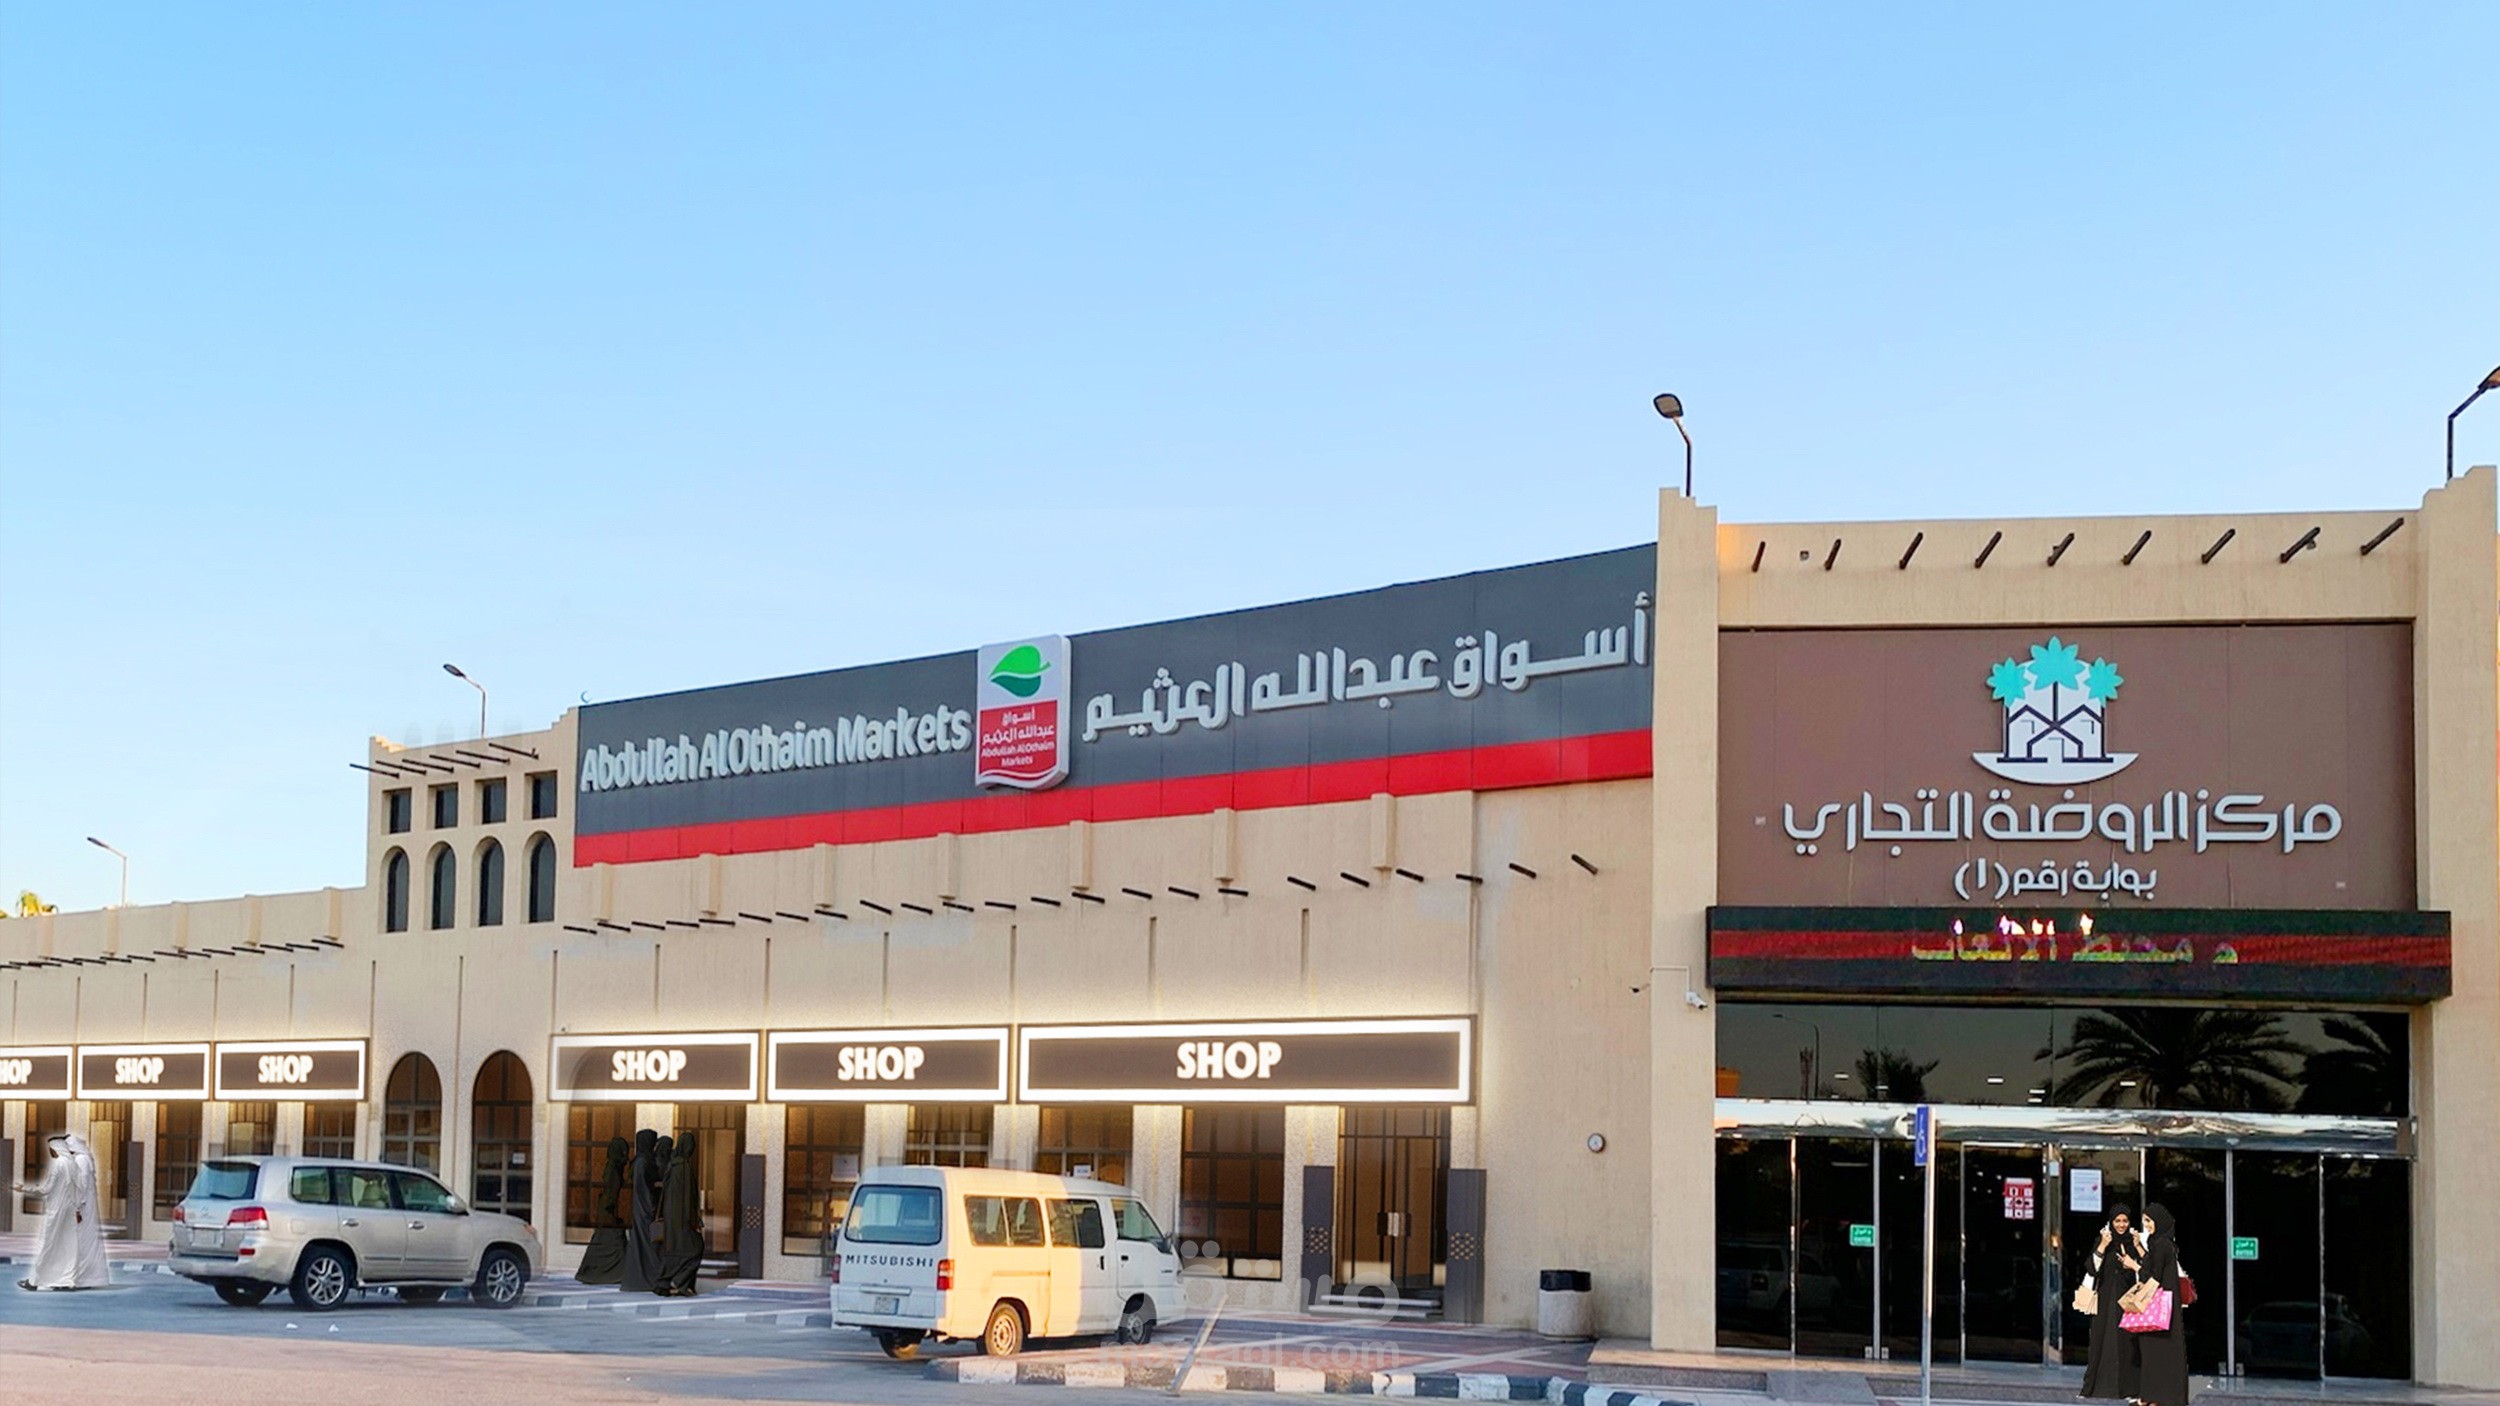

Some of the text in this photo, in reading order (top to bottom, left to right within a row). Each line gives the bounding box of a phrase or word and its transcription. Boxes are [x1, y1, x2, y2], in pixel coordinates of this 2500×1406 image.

[1447, 591, 1650, 697] أسواق
[1002, 706, 1035, 726] أسواق
[1081, 661, 1246, 742] العثيم
[581, 704, 972, 792] Abdullah AlOthaim Markets
[981, 745, 1016, 758] Abdullah
[1001, 756, 1034, 767] Markets
[1783, 789, 2342, 856] مركز الروضة التجاري
[2013, 860, 2068, 897] رقم
[2072, 858, 2157, 900] بوابة
[115, 1057, 165, 1084] SHOP
[258, 1055, 313, 1084] SHOP
[611, 1049, 687, 1082] SHOP
[837, 1046, 925, 1081] SHOP
[1176, 1041, 1283, 1079] SHOP
[845, 1254, 934, 1267] MITSUBISHI
